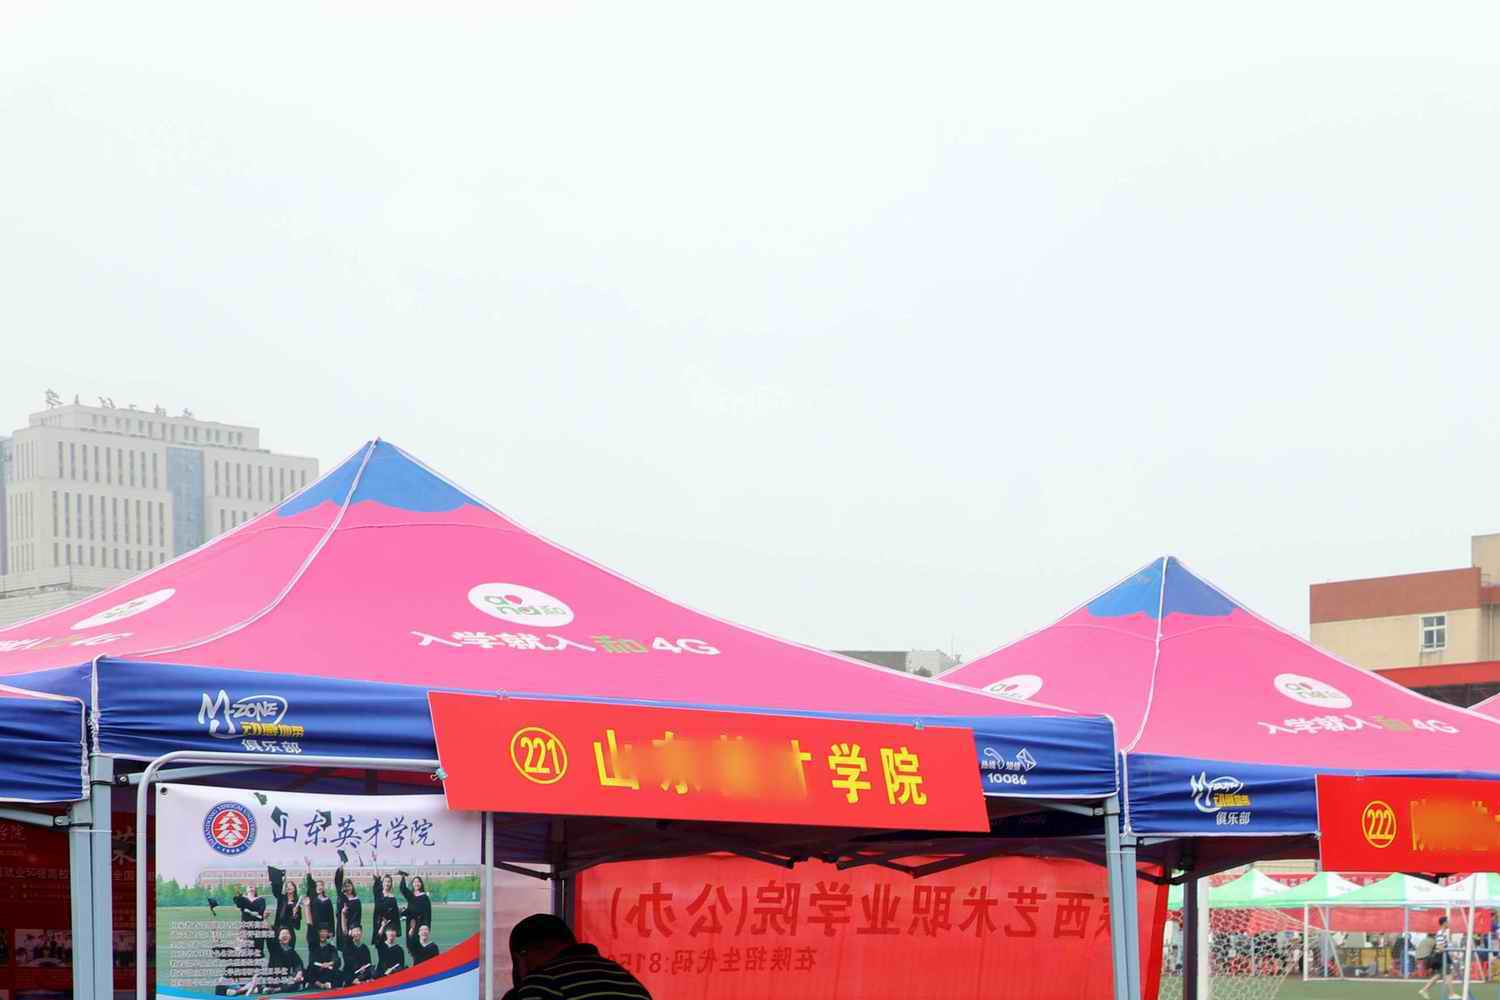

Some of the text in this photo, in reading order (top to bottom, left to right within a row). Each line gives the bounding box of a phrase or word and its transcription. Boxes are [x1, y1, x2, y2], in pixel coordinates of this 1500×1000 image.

[241, 739, 302, 754] 俱乐部
[516, 733, 564, 778] 221
[592, 728, 927, 806] 山学院
[987, 772, 1028, 786] 10086
[272, 814, 436, 849] 山东英才学院
[1365, 805, 1395, 843] 222
